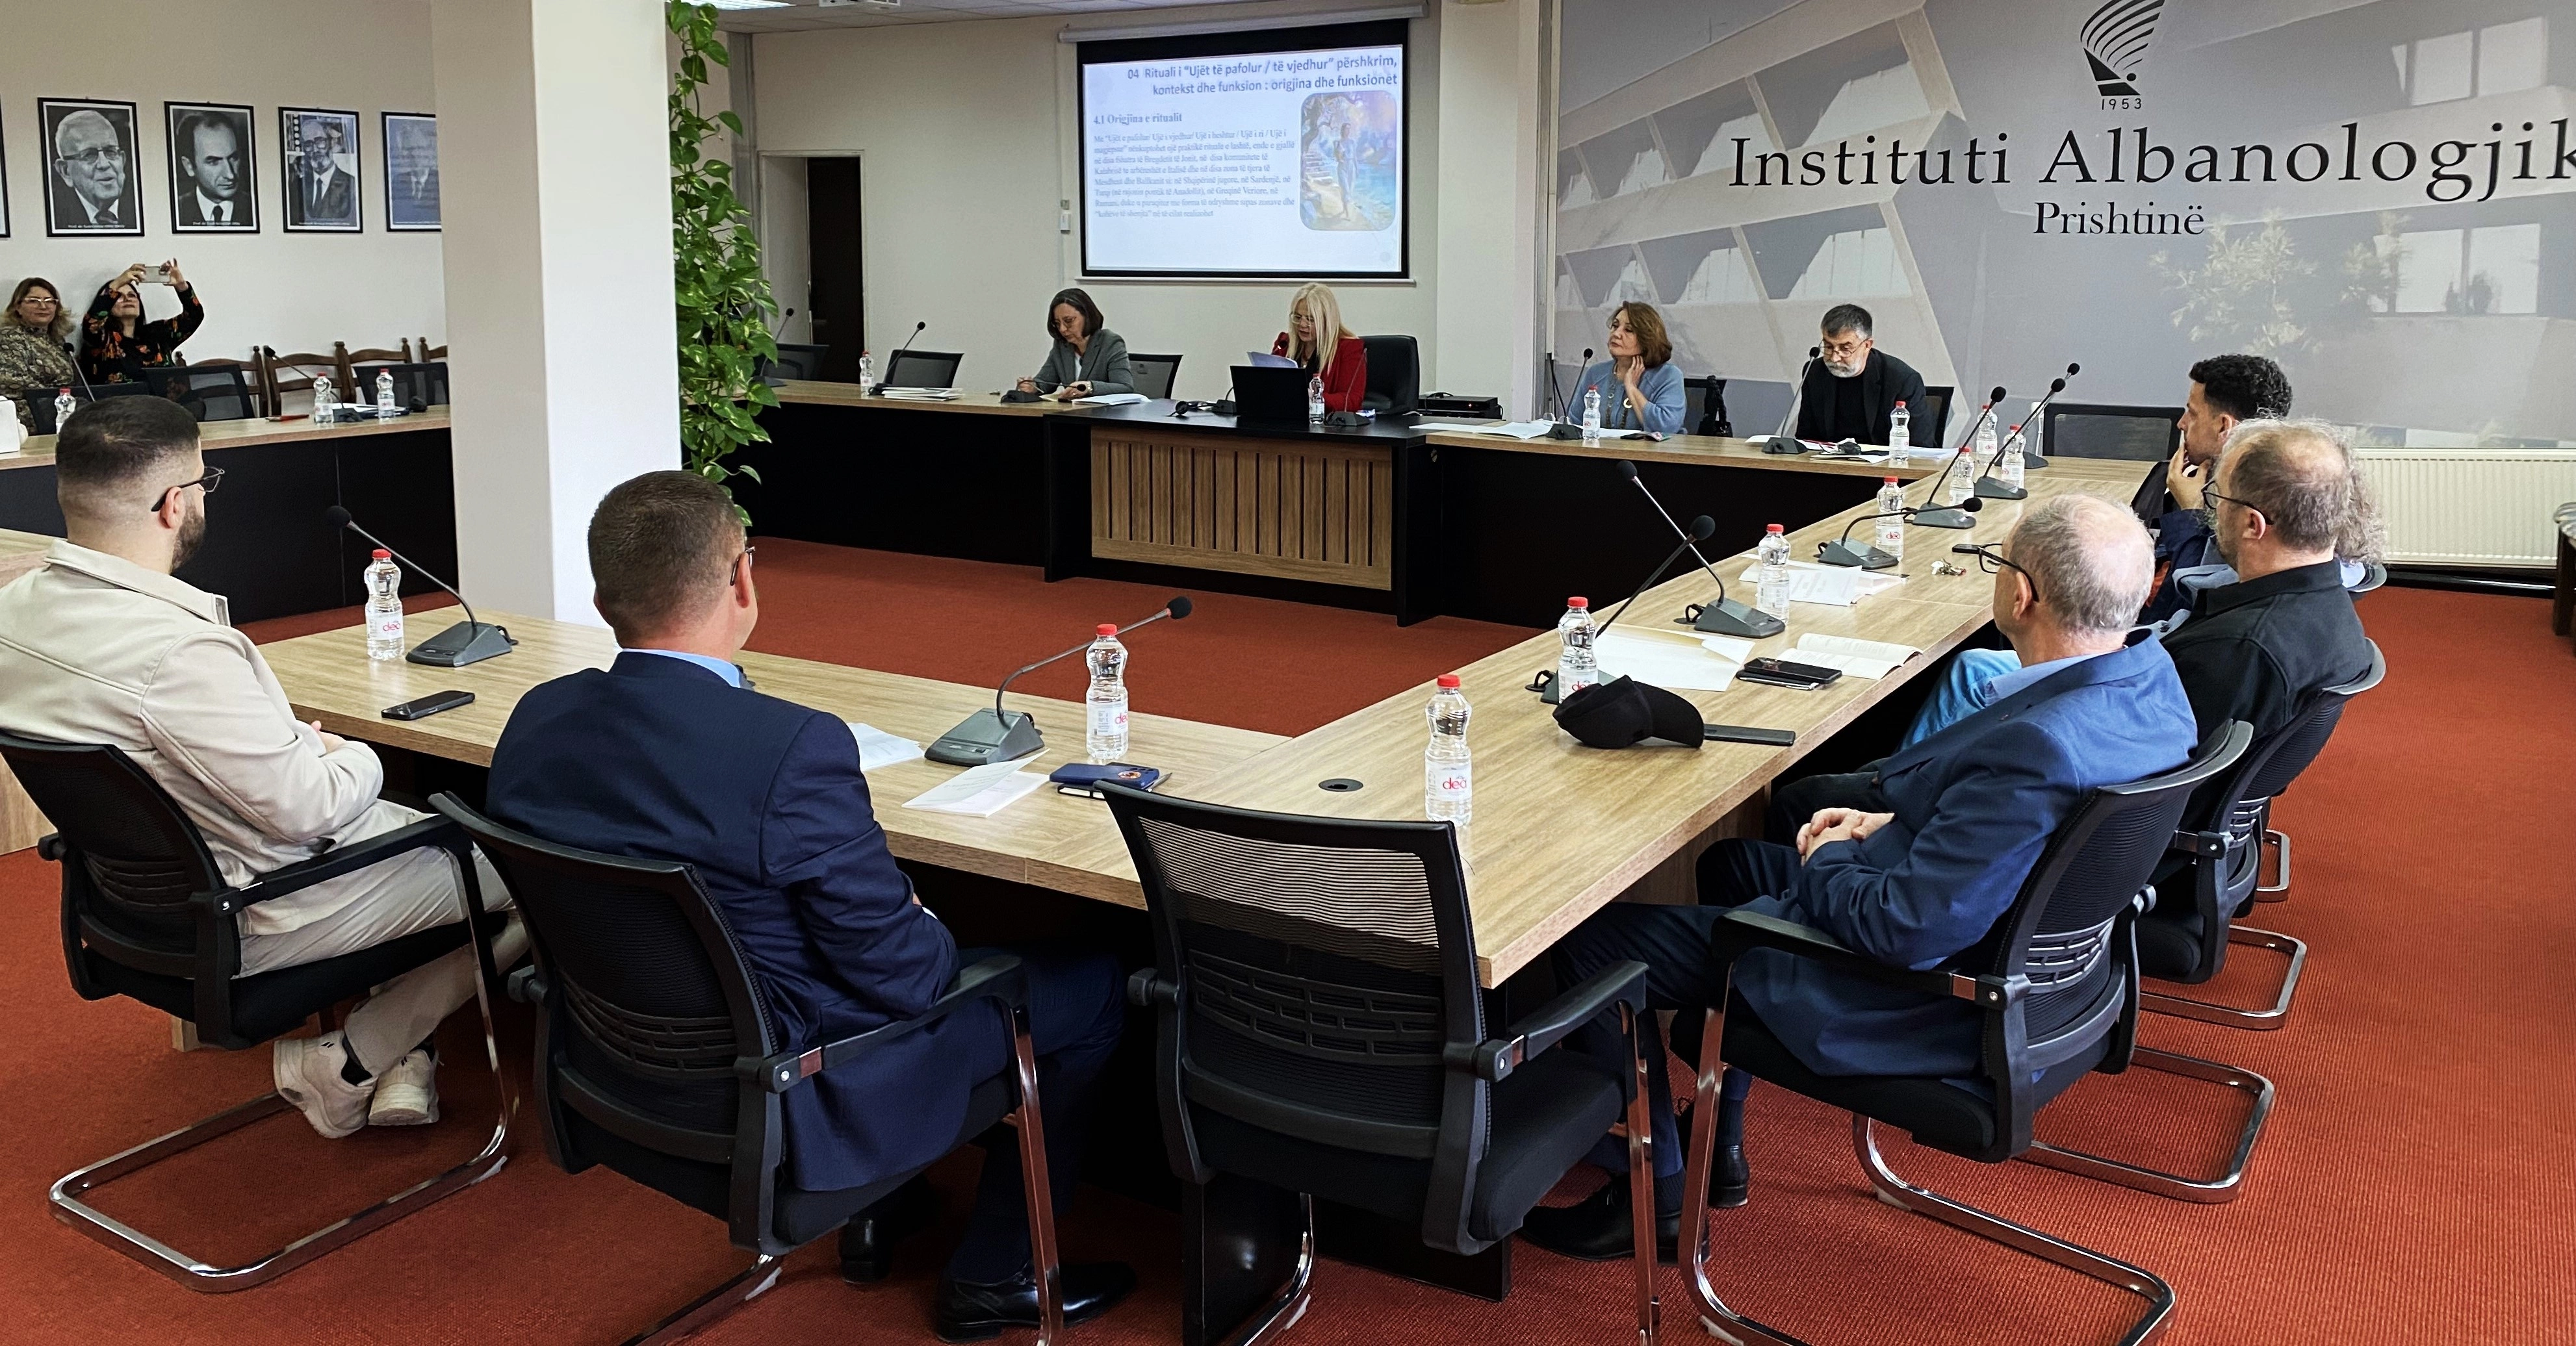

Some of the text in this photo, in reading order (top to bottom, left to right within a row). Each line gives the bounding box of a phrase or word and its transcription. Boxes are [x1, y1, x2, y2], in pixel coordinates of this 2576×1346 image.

[1127, 69, 1139, 79] 04
[1144, 67, 1176, 78] Rituali
[1178, 66, 1181, 77] i
[1213, 64, 1222, 75] të
[1225, 62, 1262, 77] pafolur
[1265, 60, 1270, 74] /
[1274, 60, 1283, 71] të
[1287, 57, 1334, 73] vjedhur”
[1337, 55, 1397, 71] përshkrim,
[1153, 83, 1194, 95] kontekst
[1197, 82, 1215, 94] dhe
[1218, 81, 1261, 92] funksion
[1271, 79, 1311, 92] origjina
[1315, 77, 1335, 88] dhe
[2101, 98, 2142, 110] 1953
[1094, 115, 1104, 124] 4.1
[1107, 114, 1142, 125] Origjina
[1152, 113, 1182, 122] ritualit
[1241, 130, 1253, 138] Ujë
[1270, 129, 1283, 138] Ujë
[1729, 118, 2576, 202] Instituti Albanologjik
[2033, 201, 2205, 235] Prishtinë
[383, 622, 400, 631] dea
[1443, 778, 1467, 789] dea
